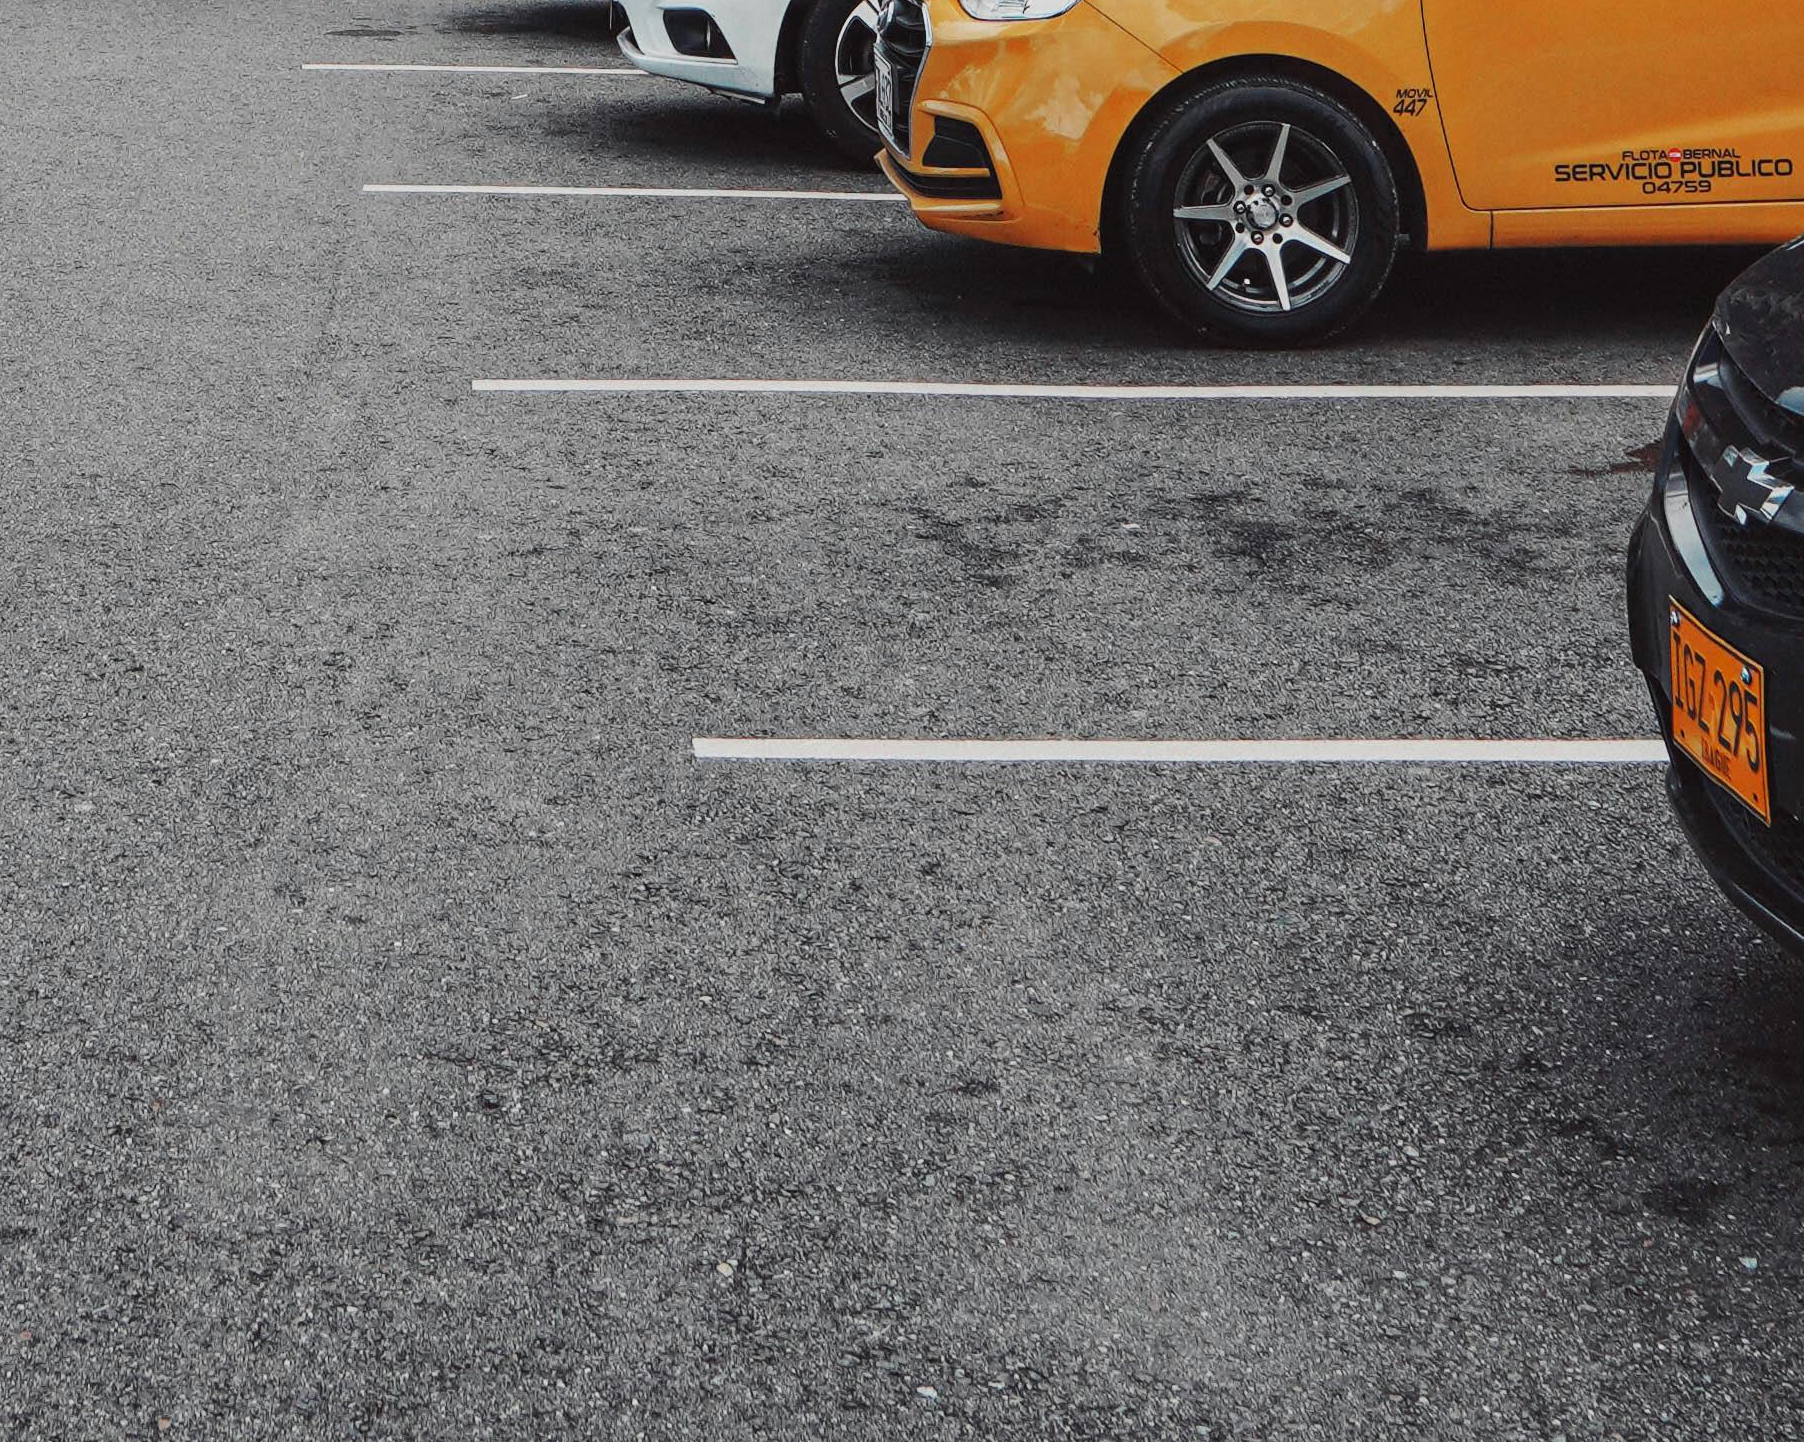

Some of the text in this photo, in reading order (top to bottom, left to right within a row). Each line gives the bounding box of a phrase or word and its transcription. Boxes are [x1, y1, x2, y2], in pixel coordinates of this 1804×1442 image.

[1396, 88, 1433, 98] MOVIL
[1392, 99, 1427, 116] 447
[1622, 148, 1741, 161] FLOTA BERNAL
[1554, 158, 1793, 182] SERVICIO PUBLICO
[1642, 180, 1712, 195] 04759
[1713, 669, 1761, 774] 295
